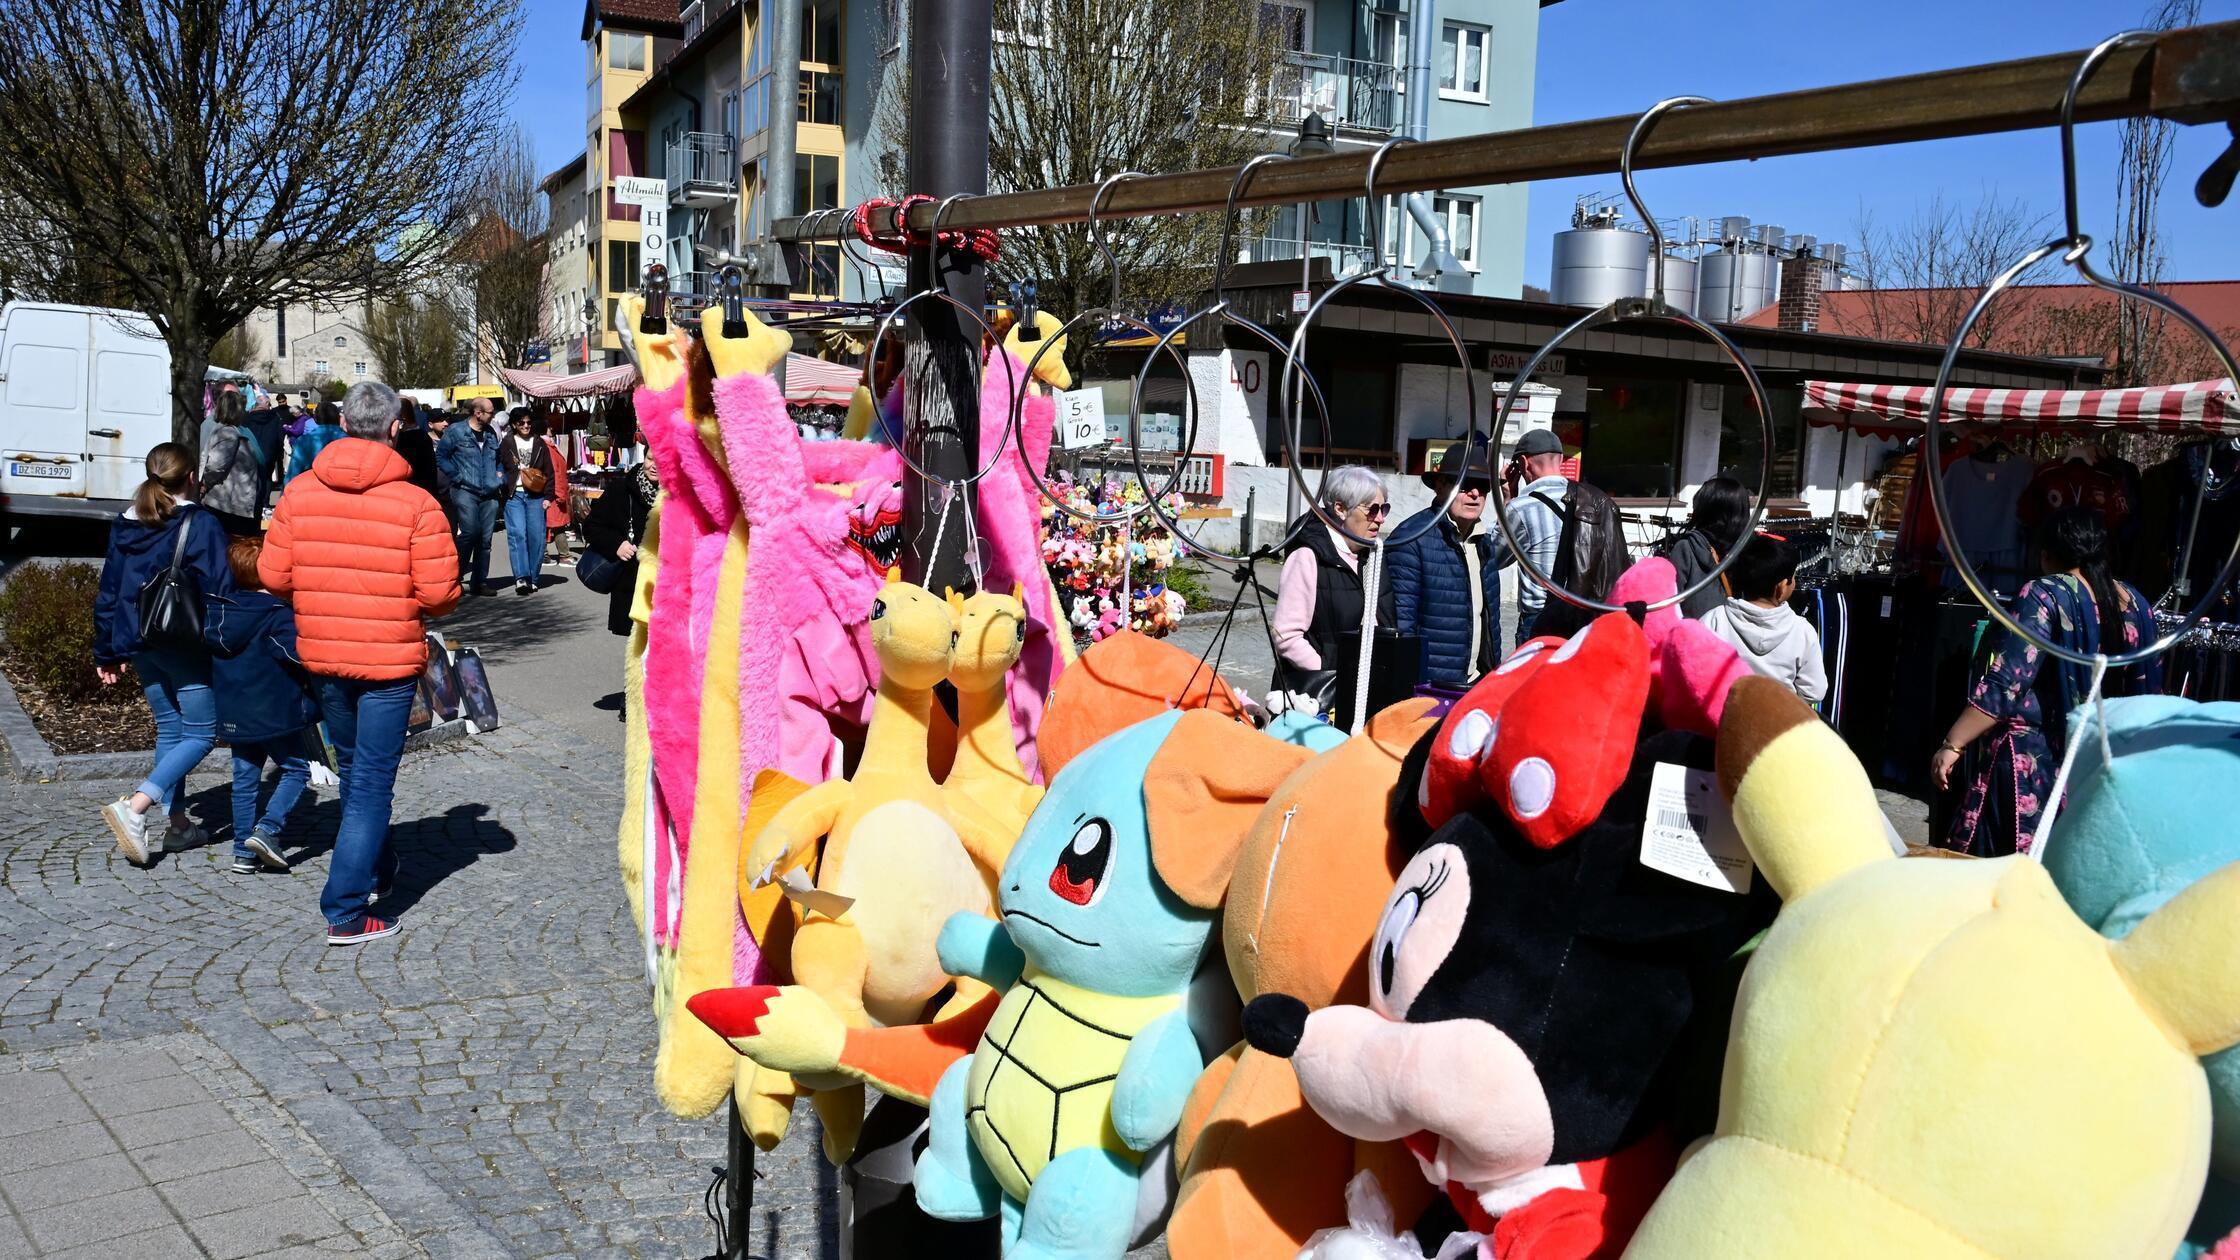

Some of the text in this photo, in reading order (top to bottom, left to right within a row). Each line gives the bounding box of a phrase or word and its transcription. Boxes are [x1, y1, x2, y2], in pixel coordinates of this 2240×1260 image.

[621, 180, 664, 196] Altmühl
[1491, 354, 1515, 369] ASIA
[1230, 359, 1261, 394] 40
[18, 465, 70, 476] DZ RG 1979
